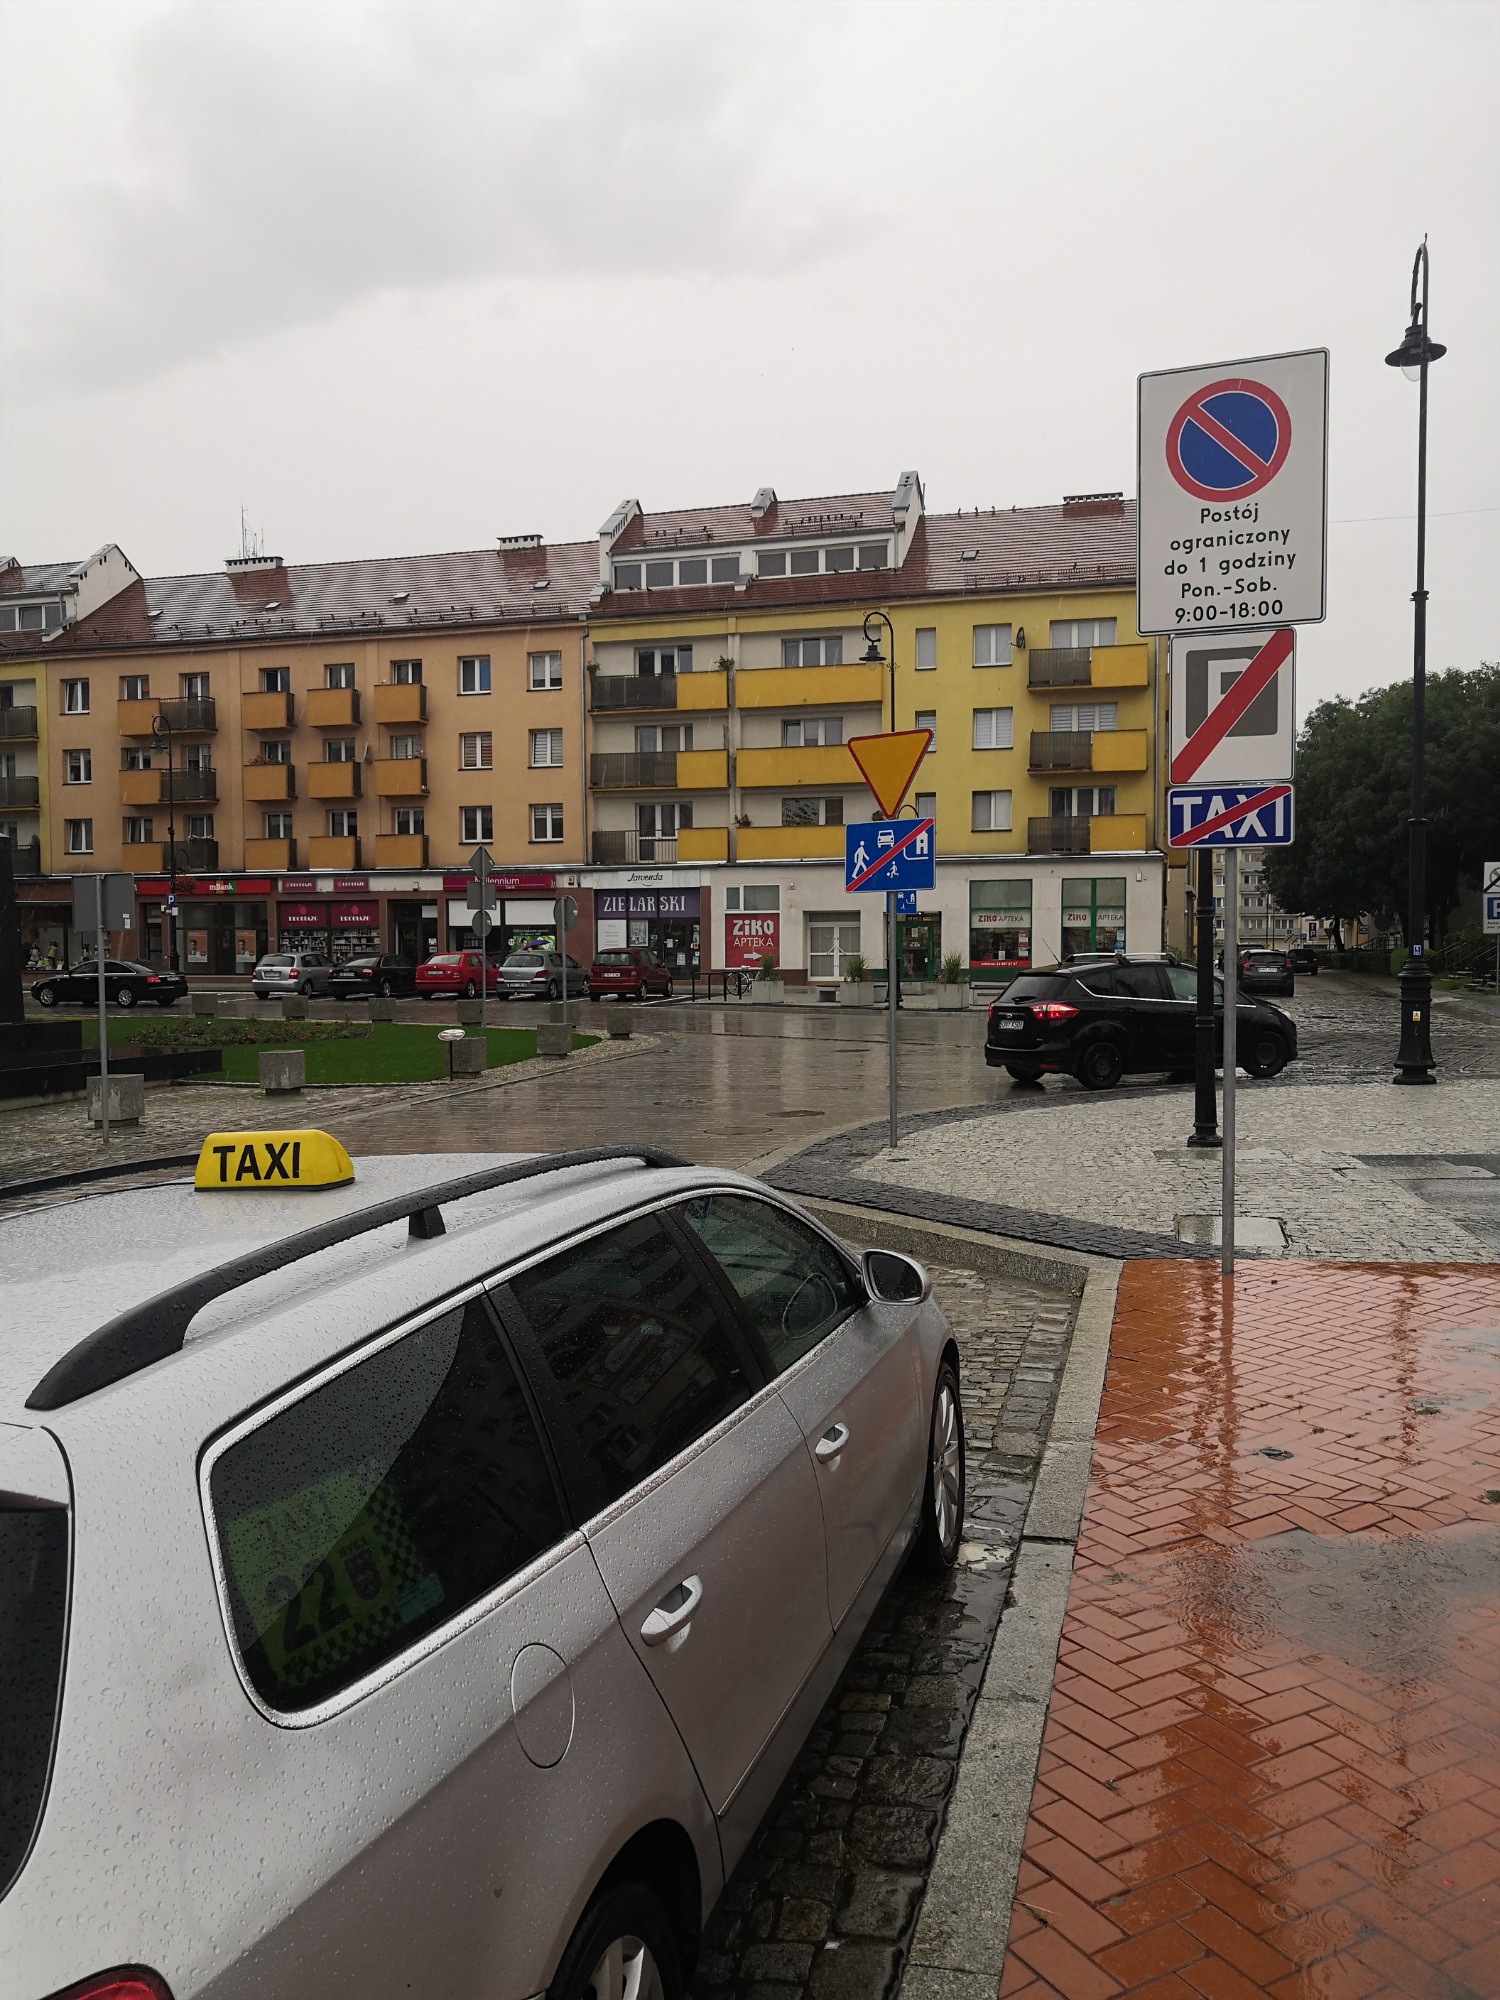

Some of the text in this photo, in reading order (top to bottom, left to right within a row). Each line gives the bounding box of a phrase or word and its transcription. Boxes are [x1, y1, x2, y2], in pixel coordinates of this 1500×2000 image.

[1200, 503, 1260, 524] Postój
[1170, 528, 1291, 555] ograniczony
[1164, 551, 1296, 576] do 1 godziny
[1175, 599, 1283, 624] 9:00-18:00
[1173, 793, 1286, 839] TAXI
[209, 882, 234, 891] mBank
[474, 876, 520, 885] Mllennium
[168, 895, 174, 905] P
[733, 937, 774, 947] APTEKA
[212, 1141, 301, 1183] TAXI
[259, 1493, 334, 1546] TAXI
